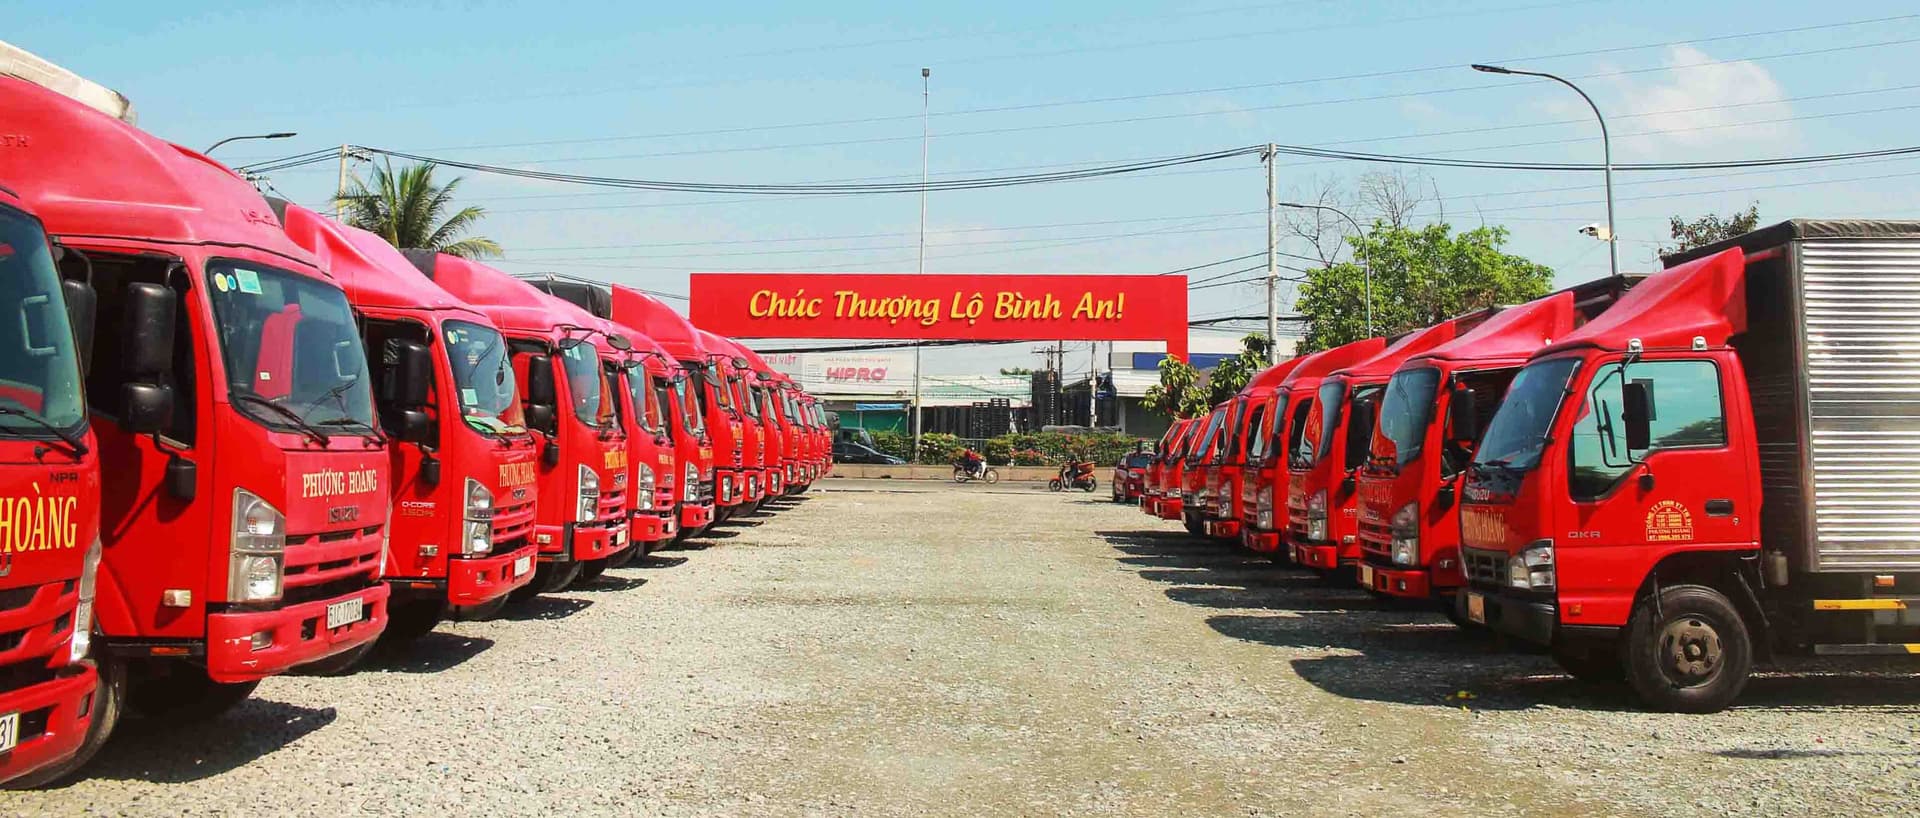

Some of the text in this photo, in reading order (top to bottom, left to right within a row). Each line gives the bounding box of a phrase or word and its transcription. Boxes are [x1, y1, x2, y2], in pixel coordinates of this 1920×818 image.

[749, 289, 1125, 326] Chúc Thượng Lộ Bình An!
[50, 472, 78, 482] NPR
[302, 463, 377, 503] PHƯỢNG HOÀNG
[0, 481, 77, 552] HOÀNG
